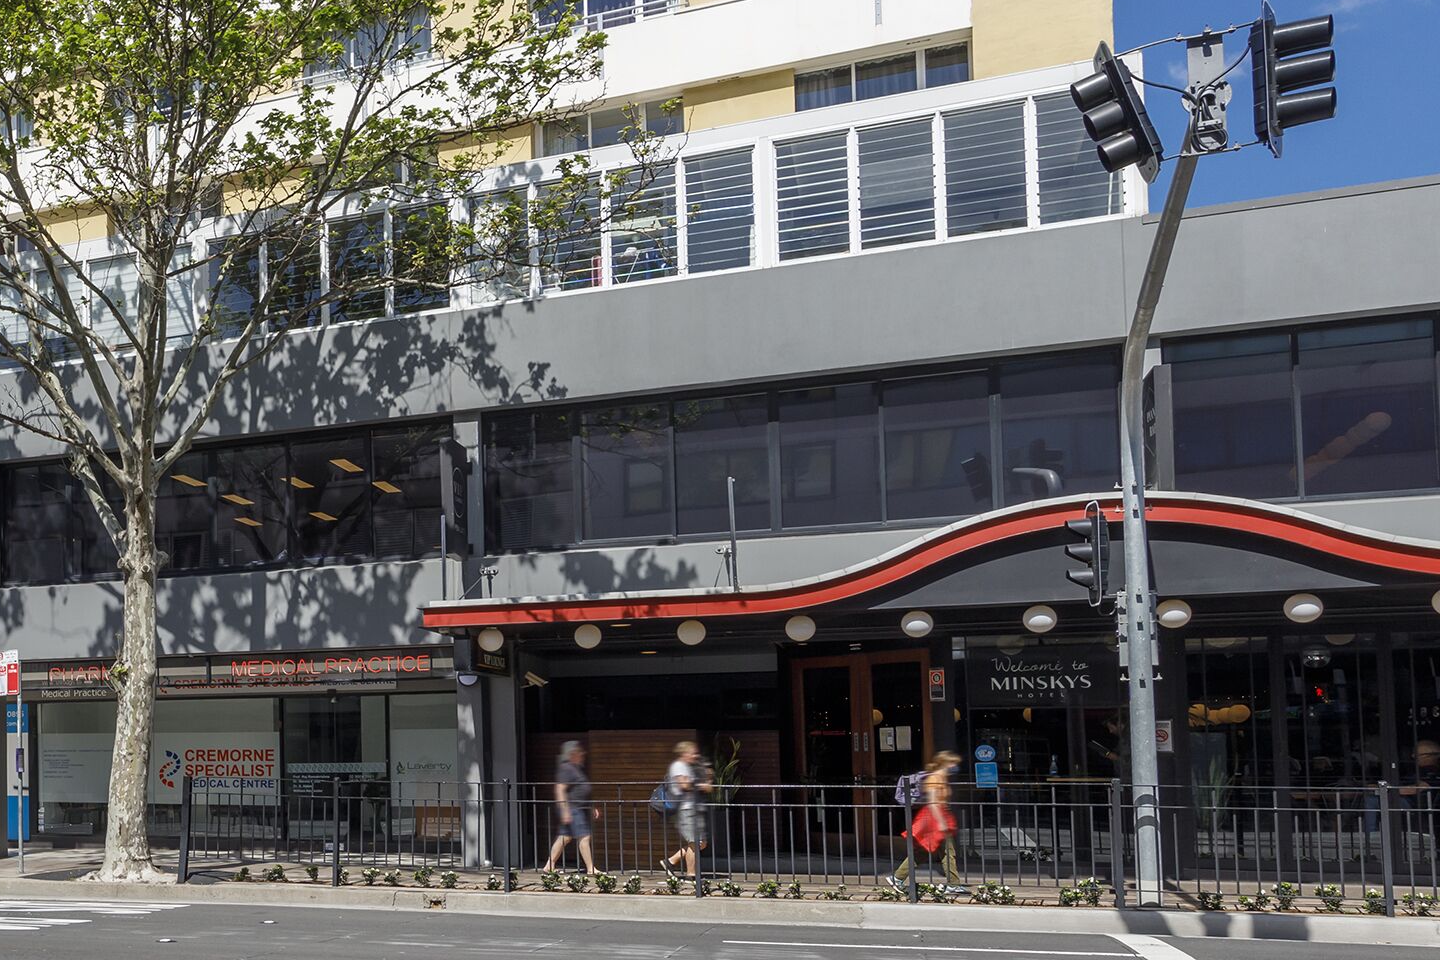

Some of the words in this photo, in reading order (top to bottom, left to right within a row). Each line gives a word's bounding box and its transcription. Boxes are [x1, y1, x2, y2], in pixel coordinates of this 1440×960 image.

[232, 658, 320, 676] MEDICAL
[325, 655, 430, 673] PRACTICE
[992, 656, 1063, 672] Welcome
[1072, 660, 1088, 670] to
[990, 674, 1092, 690] MINSKYS
[42, 690, 71, 698] Medical
[74, 688, 107, 697] Practice
[184, 749, 274, 762] CREMORNE
[185, 764, 274, 777] SPECIALIST
[192, 780, 230, 788] EDCAL
[232, 780, 274, 788] CENTRE
